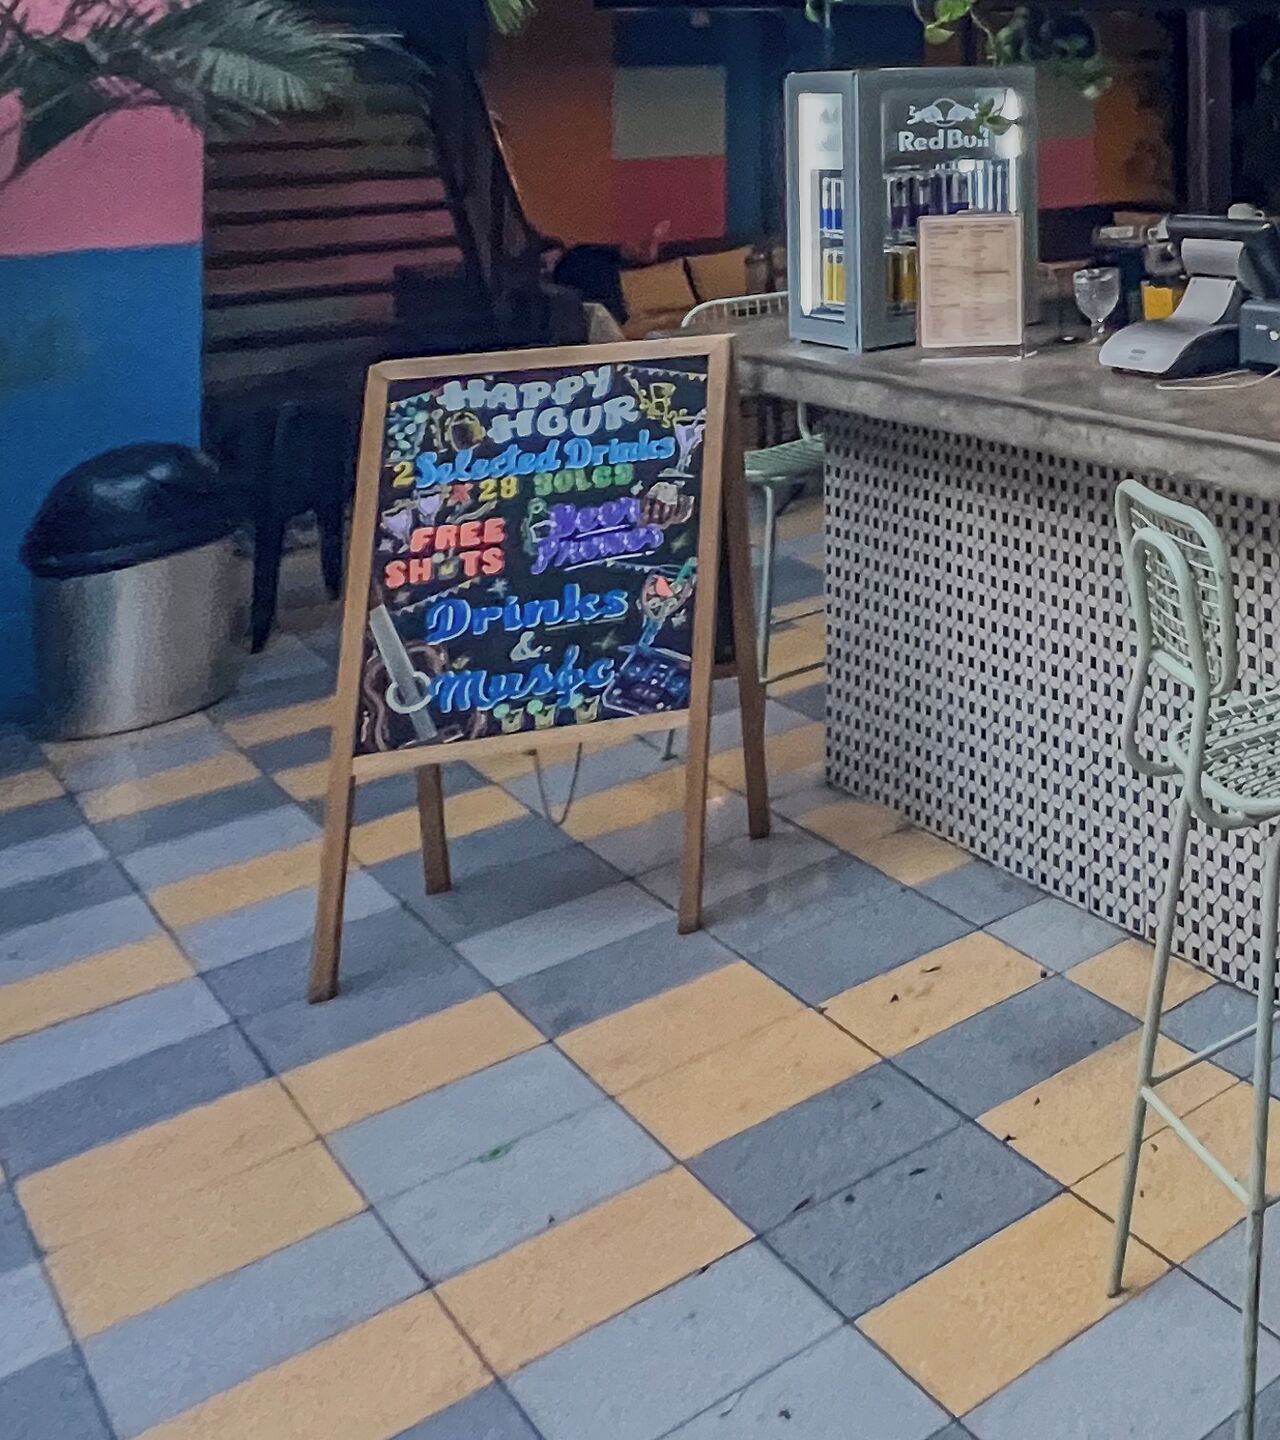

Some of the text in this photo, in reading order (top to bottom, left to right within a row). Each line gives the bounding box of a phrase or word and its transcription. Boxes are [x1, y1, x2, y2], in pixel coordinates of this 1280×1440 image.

[898, 128, 945, 153] Red
[437, 365, 612, 410] HAPPY
[487, 396, 638, 443] HOUR
[393, 429, 676, 489] 2 Selected Drinks
[479, 474, 519, 503] 28
[410, 517, 506, 552] FREE
[425, 584, 629, 645] Drinks
